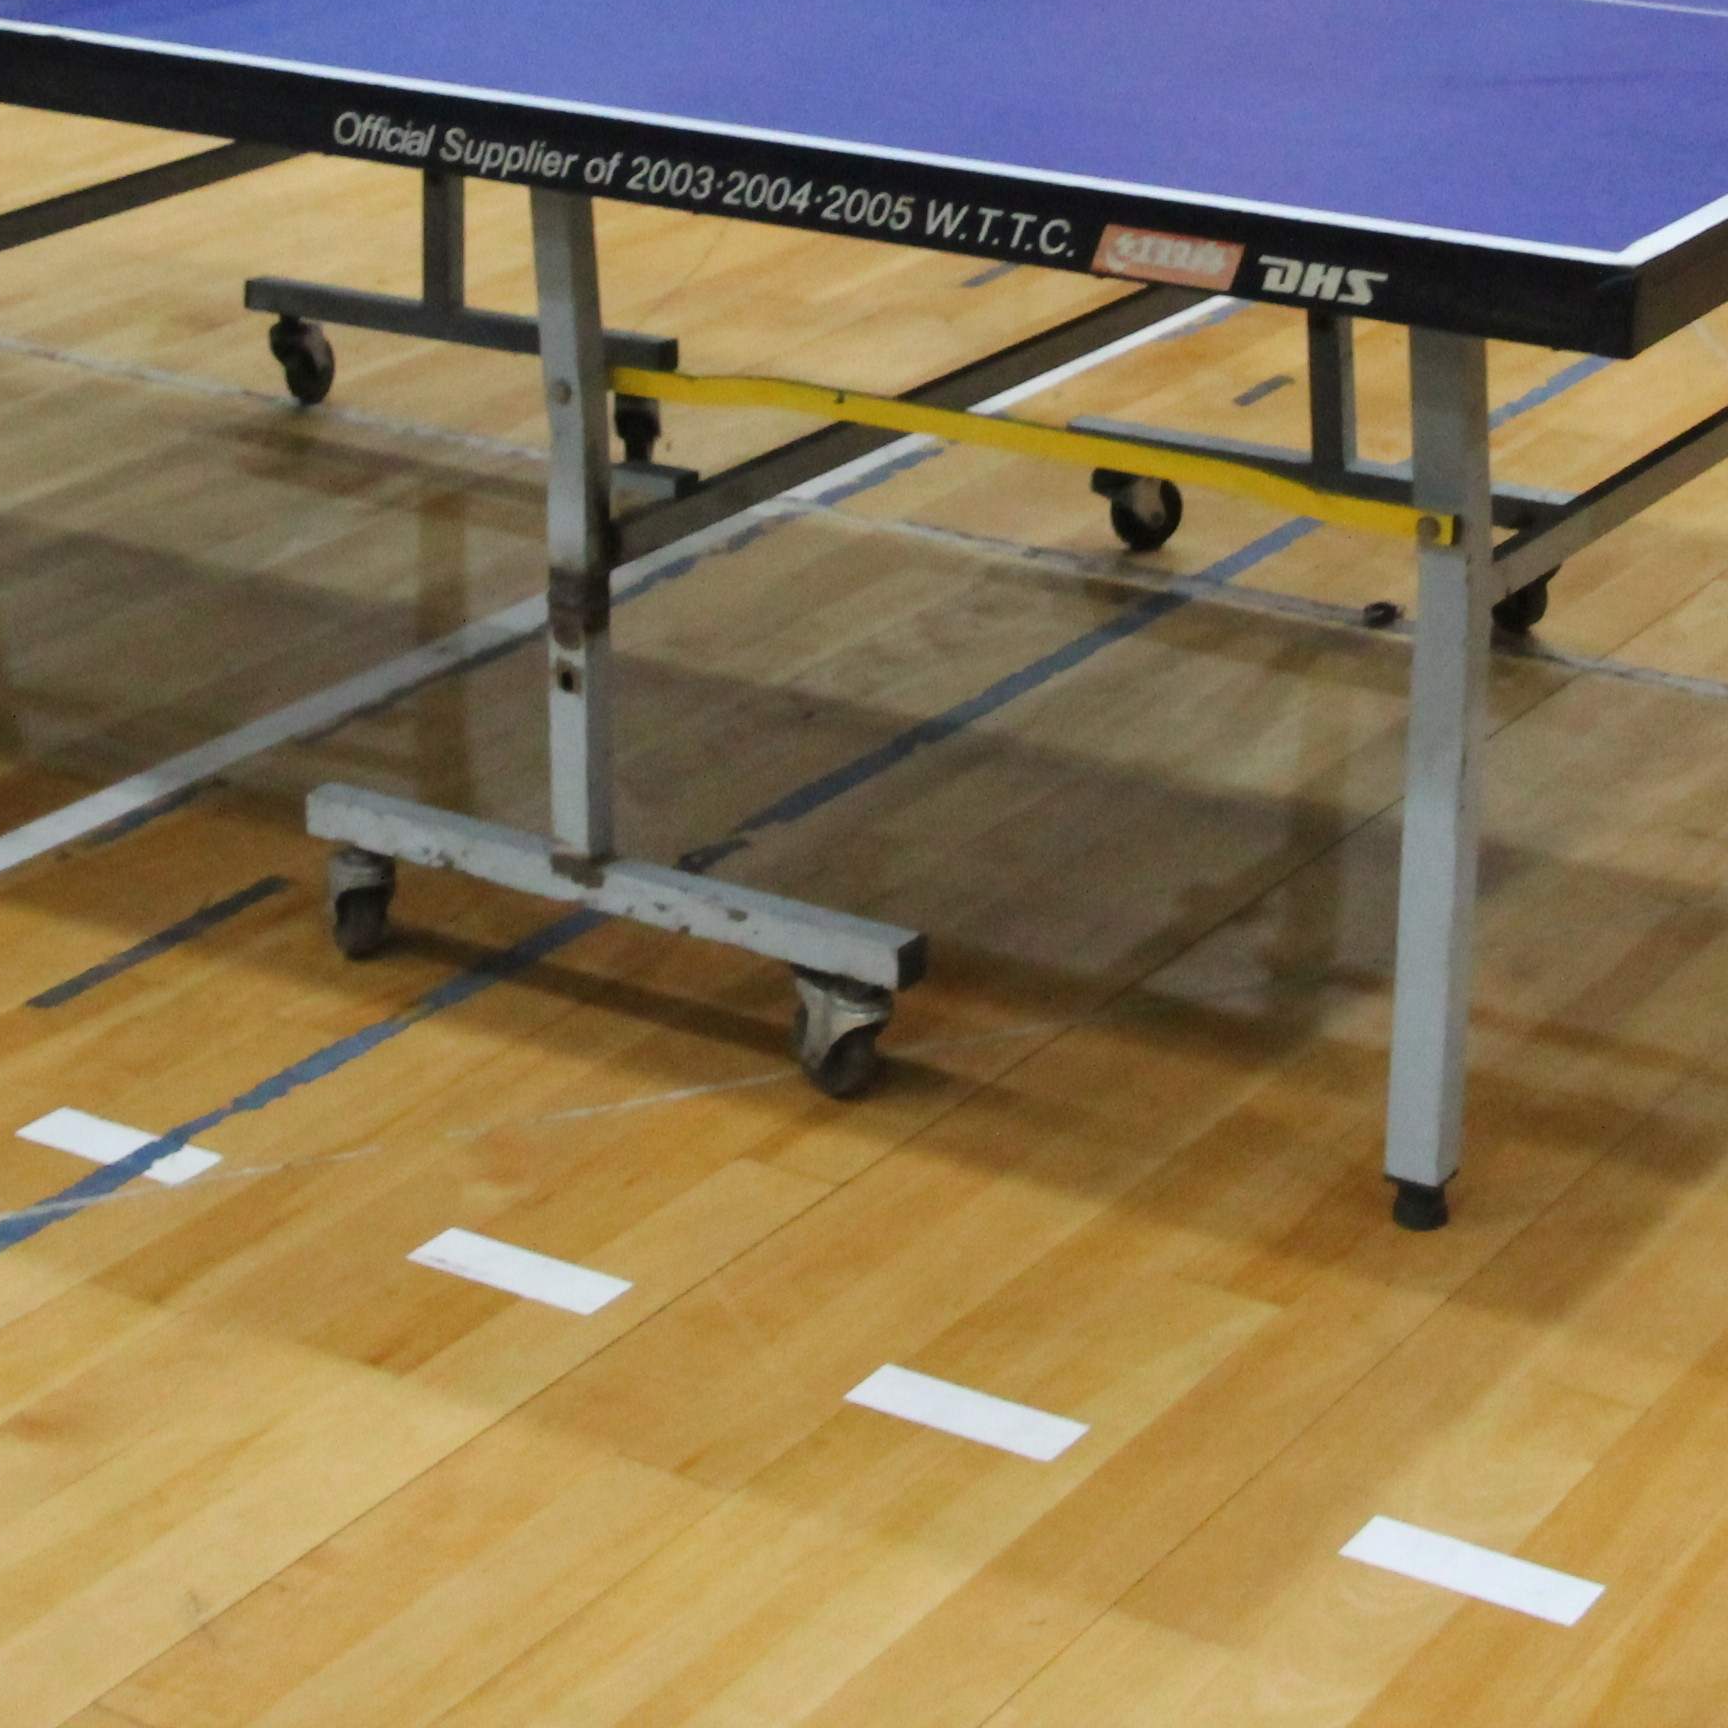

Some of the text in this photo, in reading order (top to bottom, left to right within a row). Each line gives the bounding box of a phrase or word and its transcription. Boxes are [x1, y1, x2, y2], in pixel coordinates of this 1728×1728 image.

[332, 110, 437, 158] Official
[438, 126, 577, 180] Supplier
[583, 152, 623, 186] of
[925, 198, 1077, 258] W.T.T.C.
[1257, 253, 1390, 306] DHS
